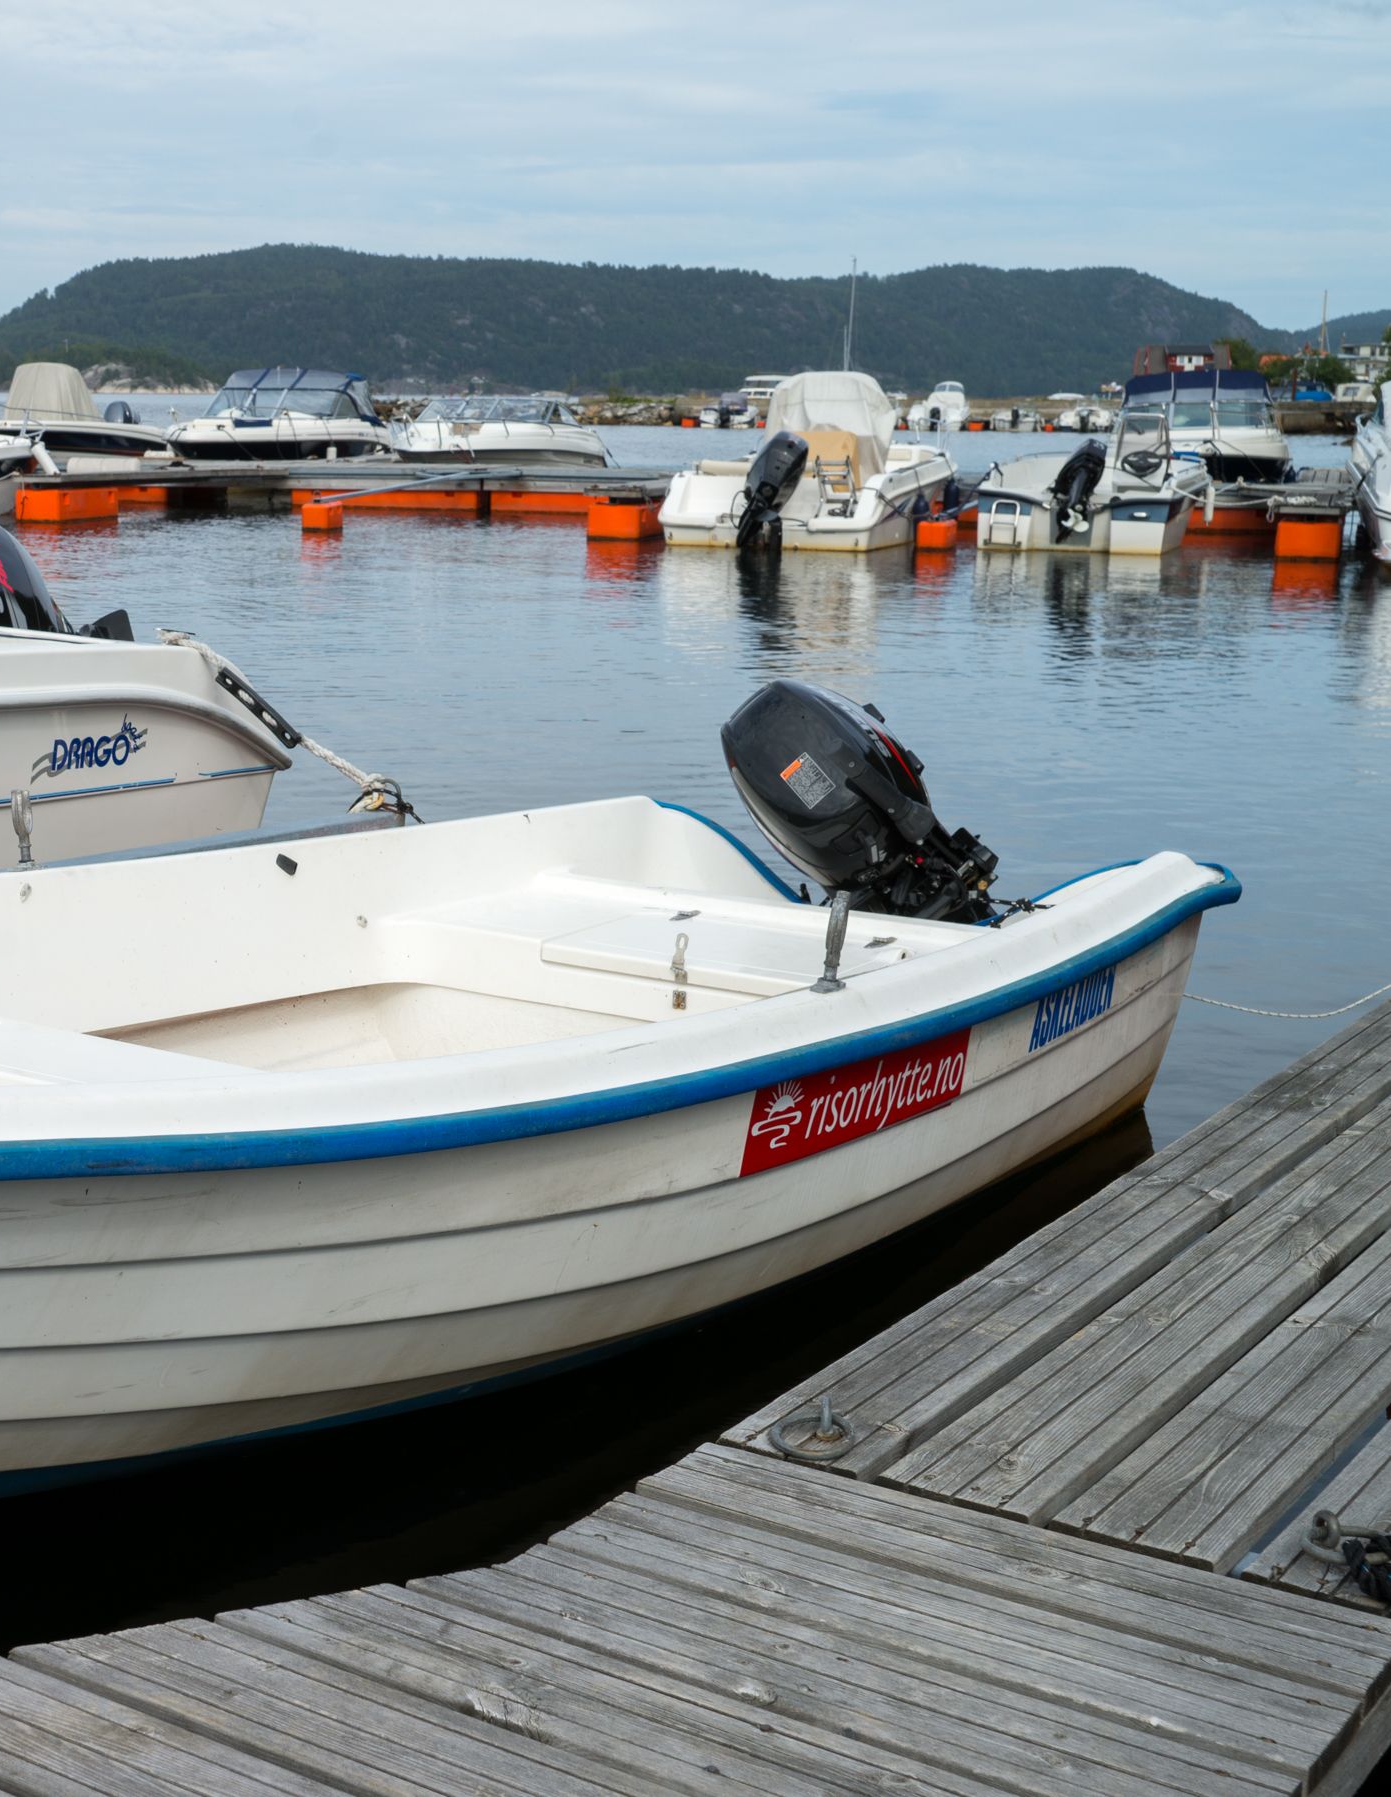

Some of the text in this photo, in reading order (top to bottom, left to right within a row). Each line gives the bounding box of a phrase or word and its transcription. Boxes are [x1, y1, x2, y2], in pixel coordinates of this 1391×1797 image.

[51, 734, 130, 771] DRAGO
[1027, 966, 1117, 1054] ASKELADDEN
[804, 1051, 965, 1140] risorhytte.no
